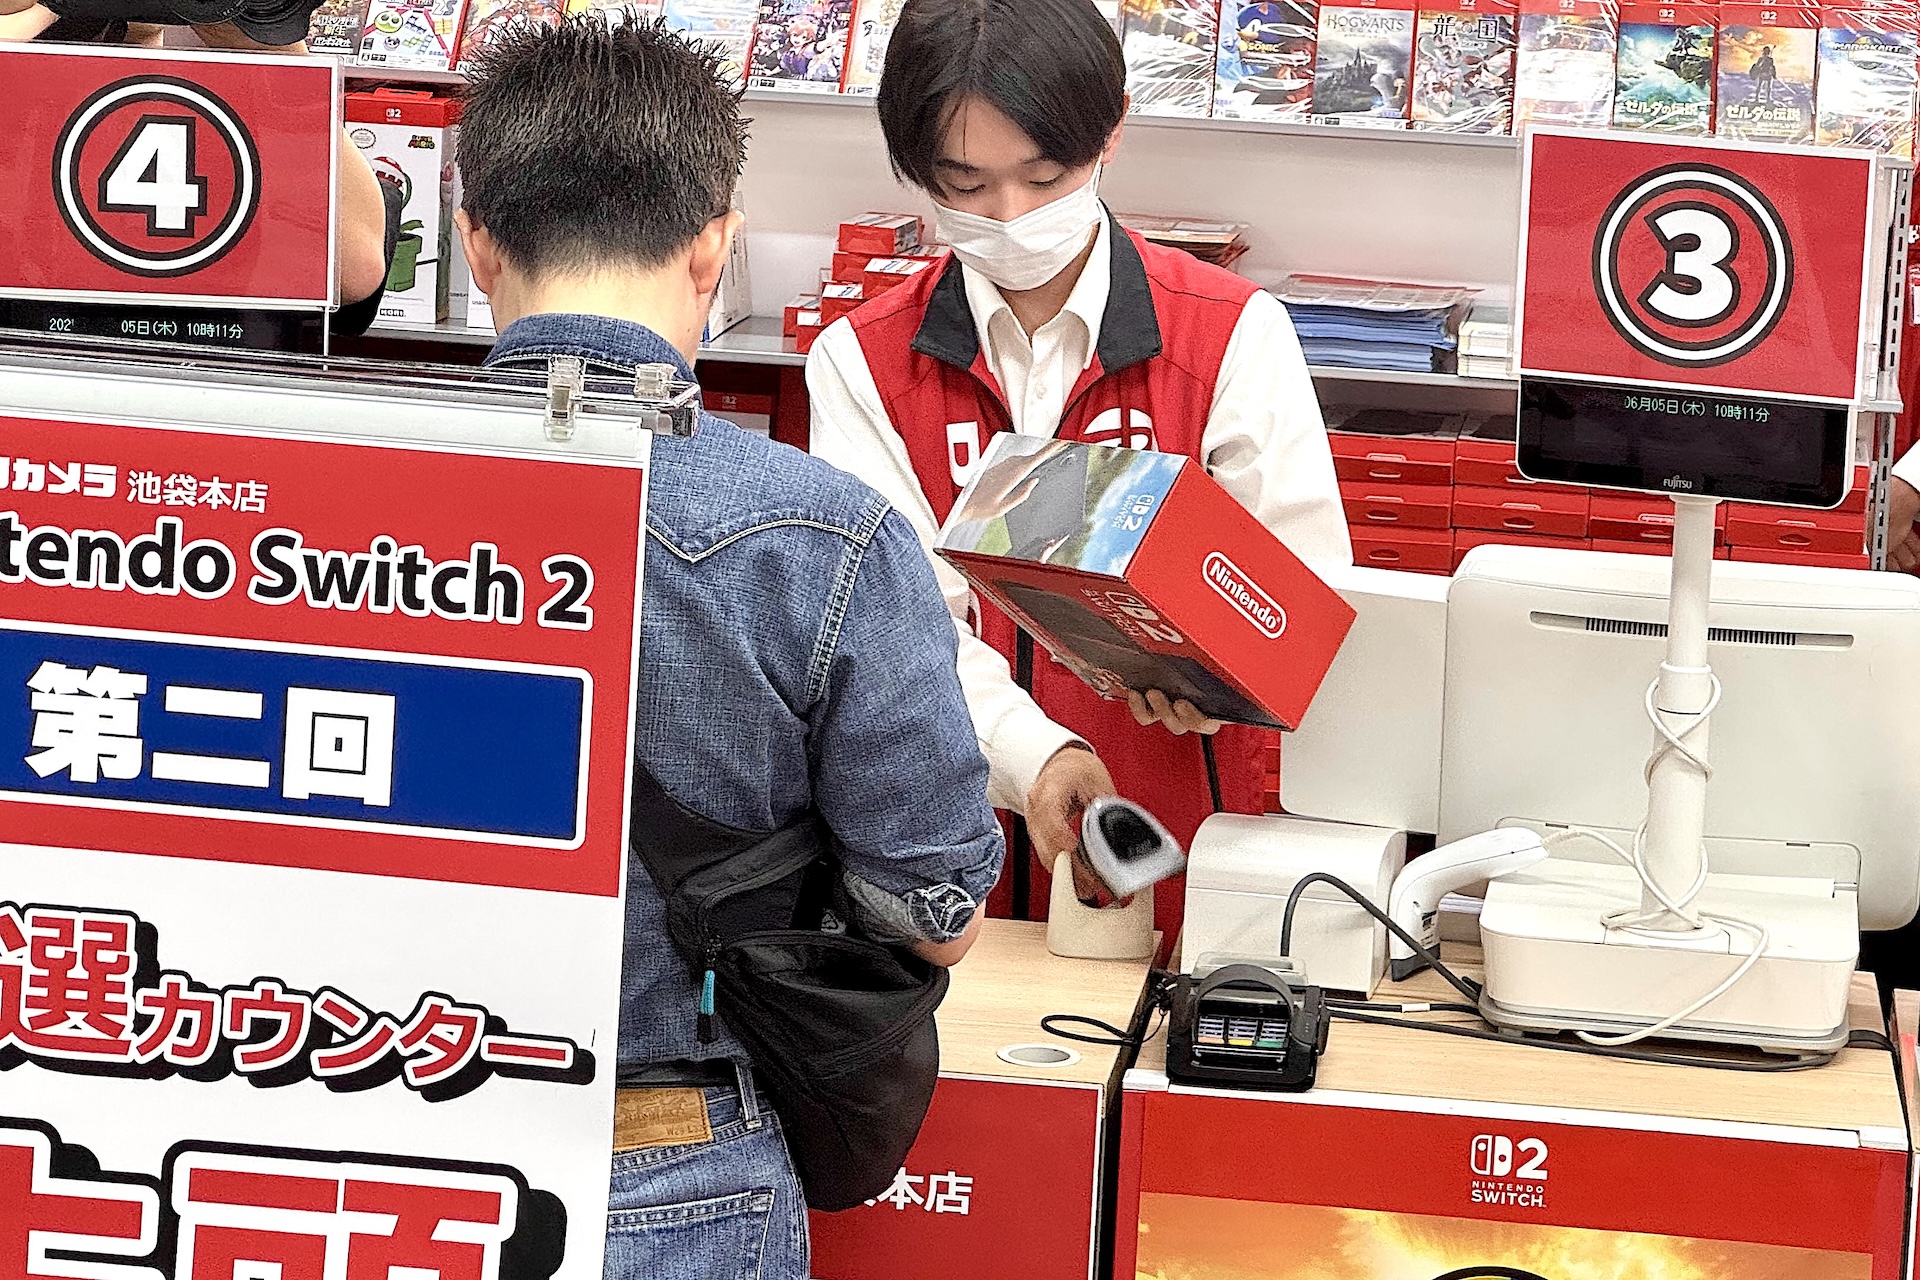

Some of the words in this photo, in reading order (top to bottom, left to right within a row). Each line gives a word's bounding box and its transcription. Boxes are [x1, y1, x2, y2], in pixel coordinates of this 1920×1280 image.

[1327, 14, 1405, 32] HOGWARTS
[1248, 42, 1280, 52] SONIC
[1725, 105, 1801, 122] ゼルダの伝説
[407, 139, 436, 149] MARIO
[105, 121, 201, 232] 4
[1645, 207, 1735, 322] 3
[187, 322, 244, 339] 10時11分
[1714, 404, 1771, 423] 10時11分
[127, 469, 269, 513] 池袋本店
[1663, 475, 1693, 490] FUJITSU
[253, 533, 519, 620] Switch
[542, 559, 589, 625] 2
[1209, 559, 1278, 629] Nintendo
[24, 661, 396, 807] 第二回
[1516, 1137, 1548, 1180] 2
[864, 1167, 974, 1215] 本店
[1472, 1180, 1544, 1194] NINTENDO
[1471, 1189, 1543, 1207] SWITCH
